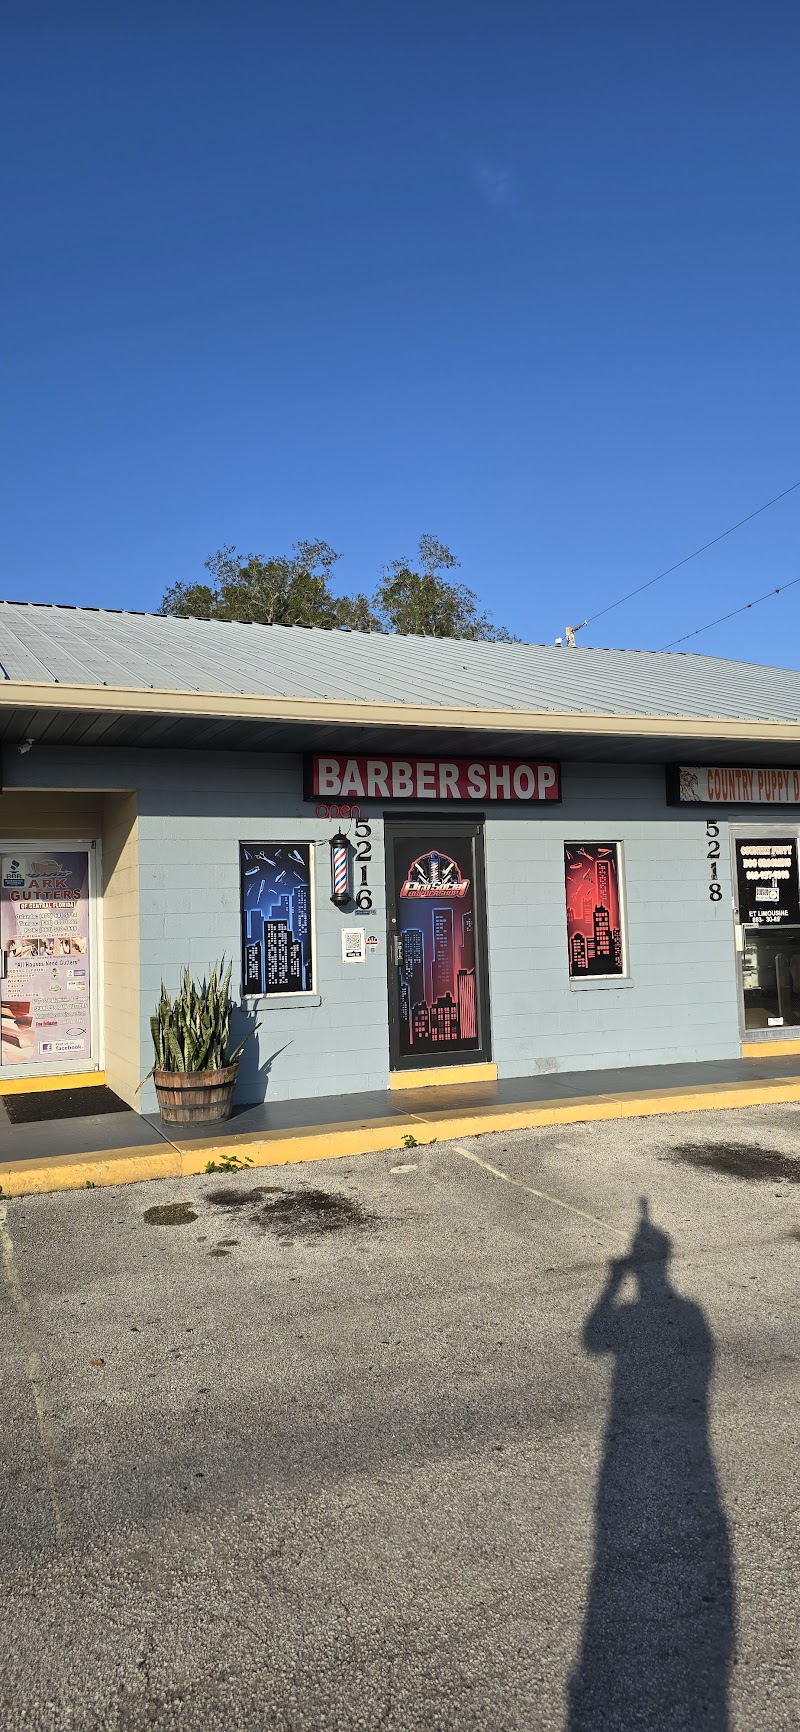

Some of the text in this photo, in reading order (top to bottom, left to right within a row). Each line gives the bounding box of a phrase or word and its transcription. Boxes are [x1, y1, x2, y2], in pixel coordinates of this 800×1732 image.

[318, 758, 556, 800] BARBER SHOP
[707, 769, 754, 801] COUNTRY
[757, 770, 789, 801] PUPPY
[316, 804, 362, 822] open
[28, 879, 67, 889] ARK
[10, 889, 81, 902] GUTTERS
[29, 902, 52, 910] CENTRAL
